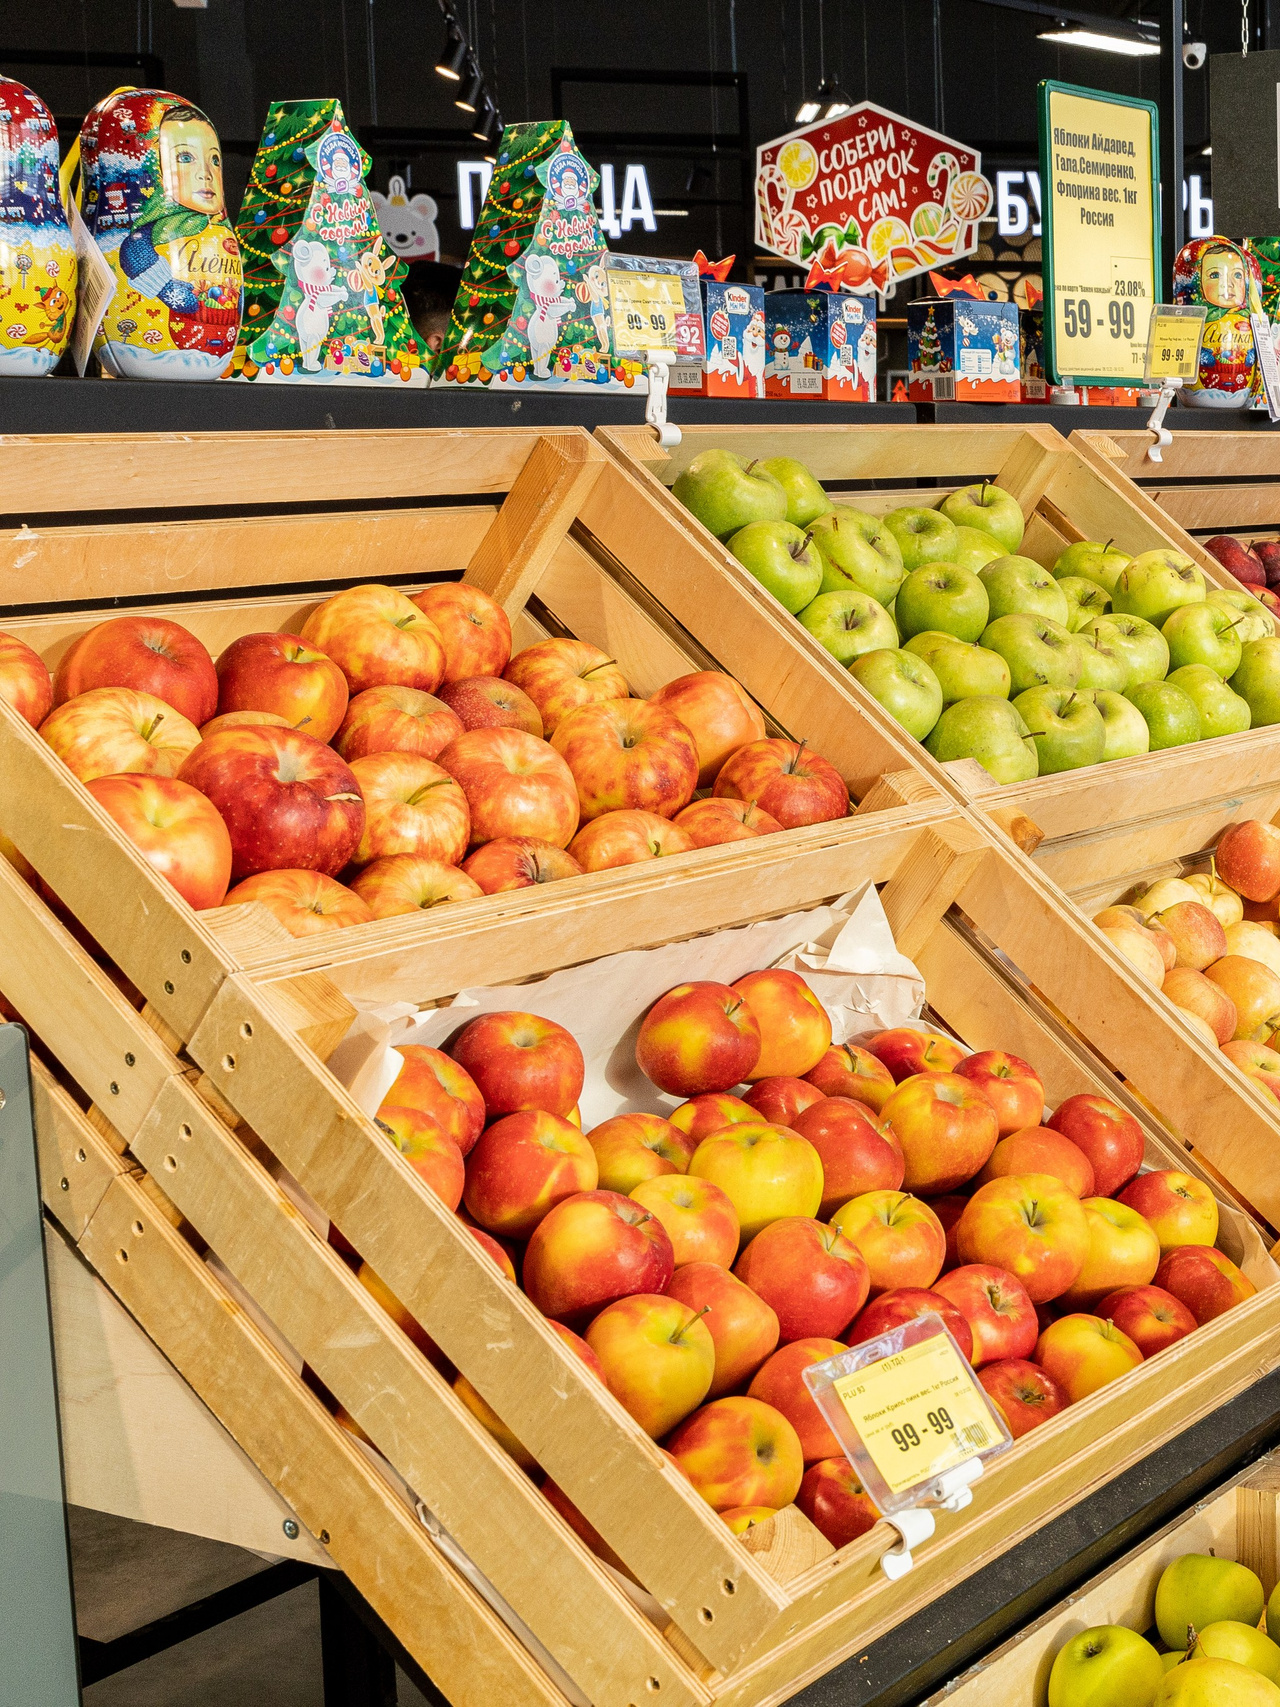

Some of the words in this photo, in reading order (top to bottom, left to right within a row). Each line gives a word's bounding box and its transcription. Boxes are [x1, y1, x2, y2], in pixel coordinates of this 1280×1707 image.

[819, 123, 896, 174] СОБЕРИ
[1054, 127, 1090, 150] Яблоки
[1092, 133, 1136, 158] Айдаред,
[819, 147, 920, 206] ПОДАРОК
[858, 177, 908, 222] САМ!
[1102, 187, 1122, 203] вес.
[1123, 187, 1138, 205] 1кг
[311, 203, 323, 224] С
[326, 198, 370, 224] Новым
[1080, 207, 1115, 228] Россия
[320, 212, 368, 245] годом!
[541, 219, 553, 239] С
[556, 214, 597, 238] Новым
[550, 227, 596, 259] годом!
[1114, 280, 1146, 297] 23.08%
[680, 325, 701, 344] 92
[843, 1390, 857, 1400] PLU
[863, 1409, 887, 1423] Яблоки
[886, 1400, 906, 1412] Крипс
[940, 1375, 959, 1387] Россия
